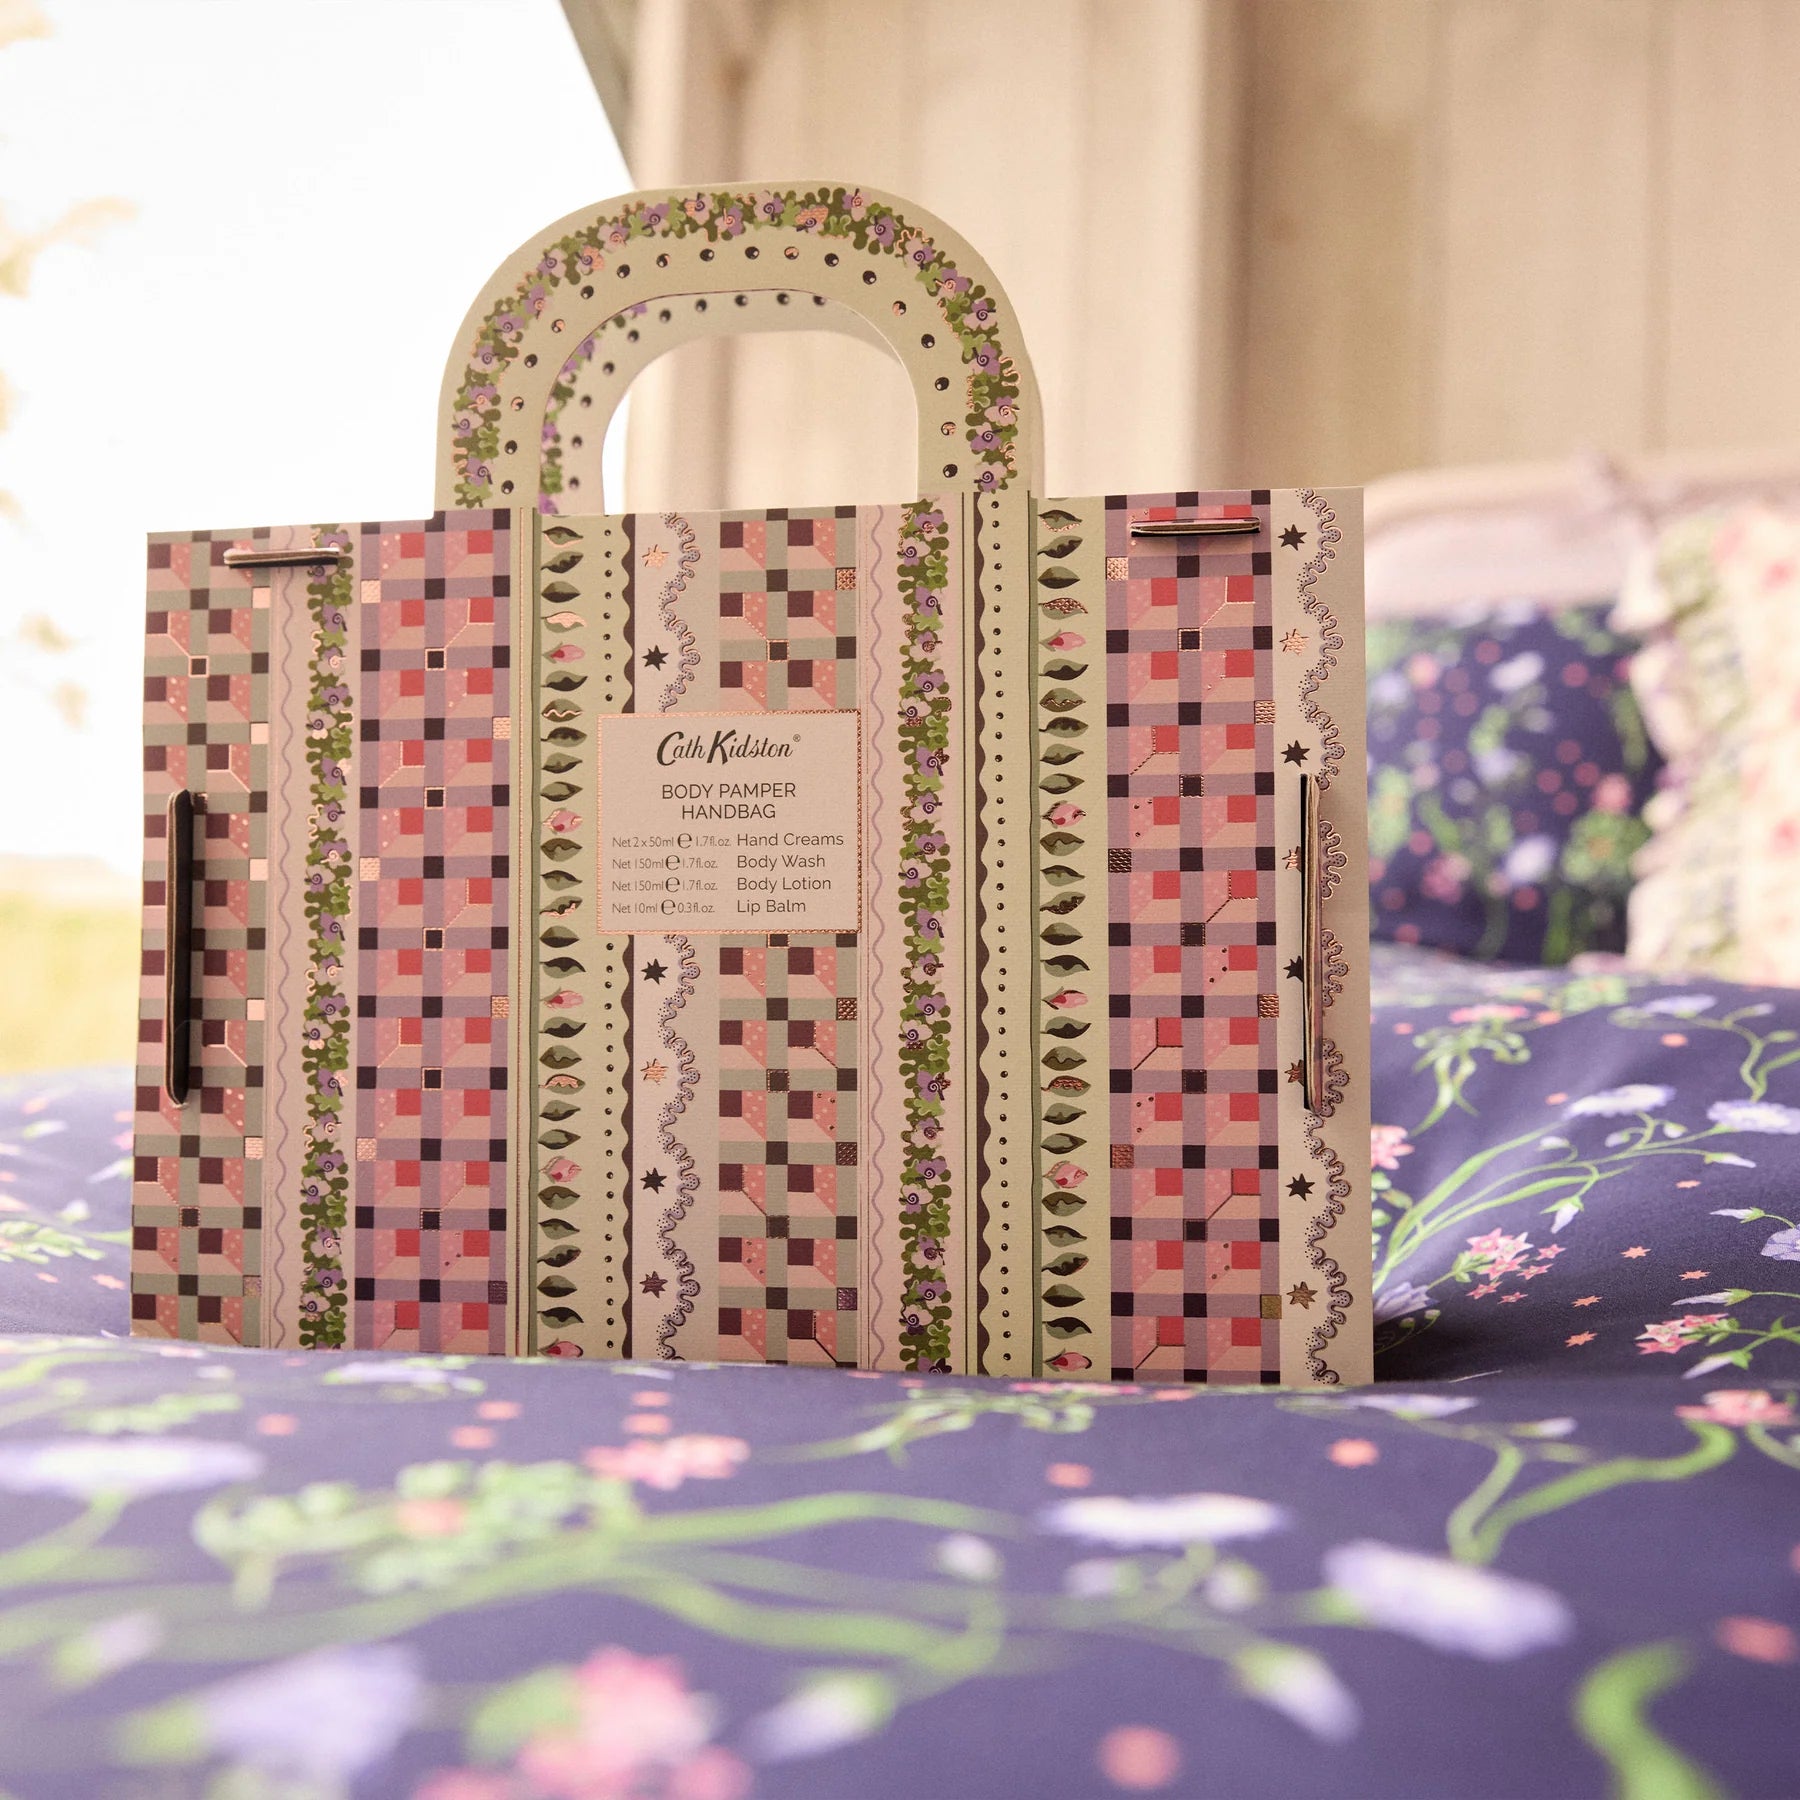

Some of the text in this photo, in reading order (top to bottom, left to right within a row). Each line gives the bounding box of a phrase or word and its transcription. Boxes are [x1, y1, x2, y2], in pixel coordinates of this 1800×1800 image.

[656, 731, 706, 766] Cath
[662, 782, 796, 799] BODY PAMPER
[682, 803, 776, 820] HANDBAG
[612, 836, 631, 848] Net
[633, 836, 640, 847] 2
[649, 836, 674, 848] 50ml
[737, 833, 778, 846] Hand
[783, 832, 844, 846] Creams
[612, 858, 631, 869] Net
[634, 858, 664, 869] 150ml
[737, 855, 778, 872] Body
[781, 854, 826, 868] Wash
[611, 880, 631, 891] Net
[634, 880, 664, 891] 150ml
[737, 877, 778, 894] Body
[782, 876, 832, 890] Lotion
[611, 902, 631, 913] Net
[634, 902, 658, 913] 10ml
[737, 899, 761, 916] Lip
[766, 899, 806, 913] Balm
